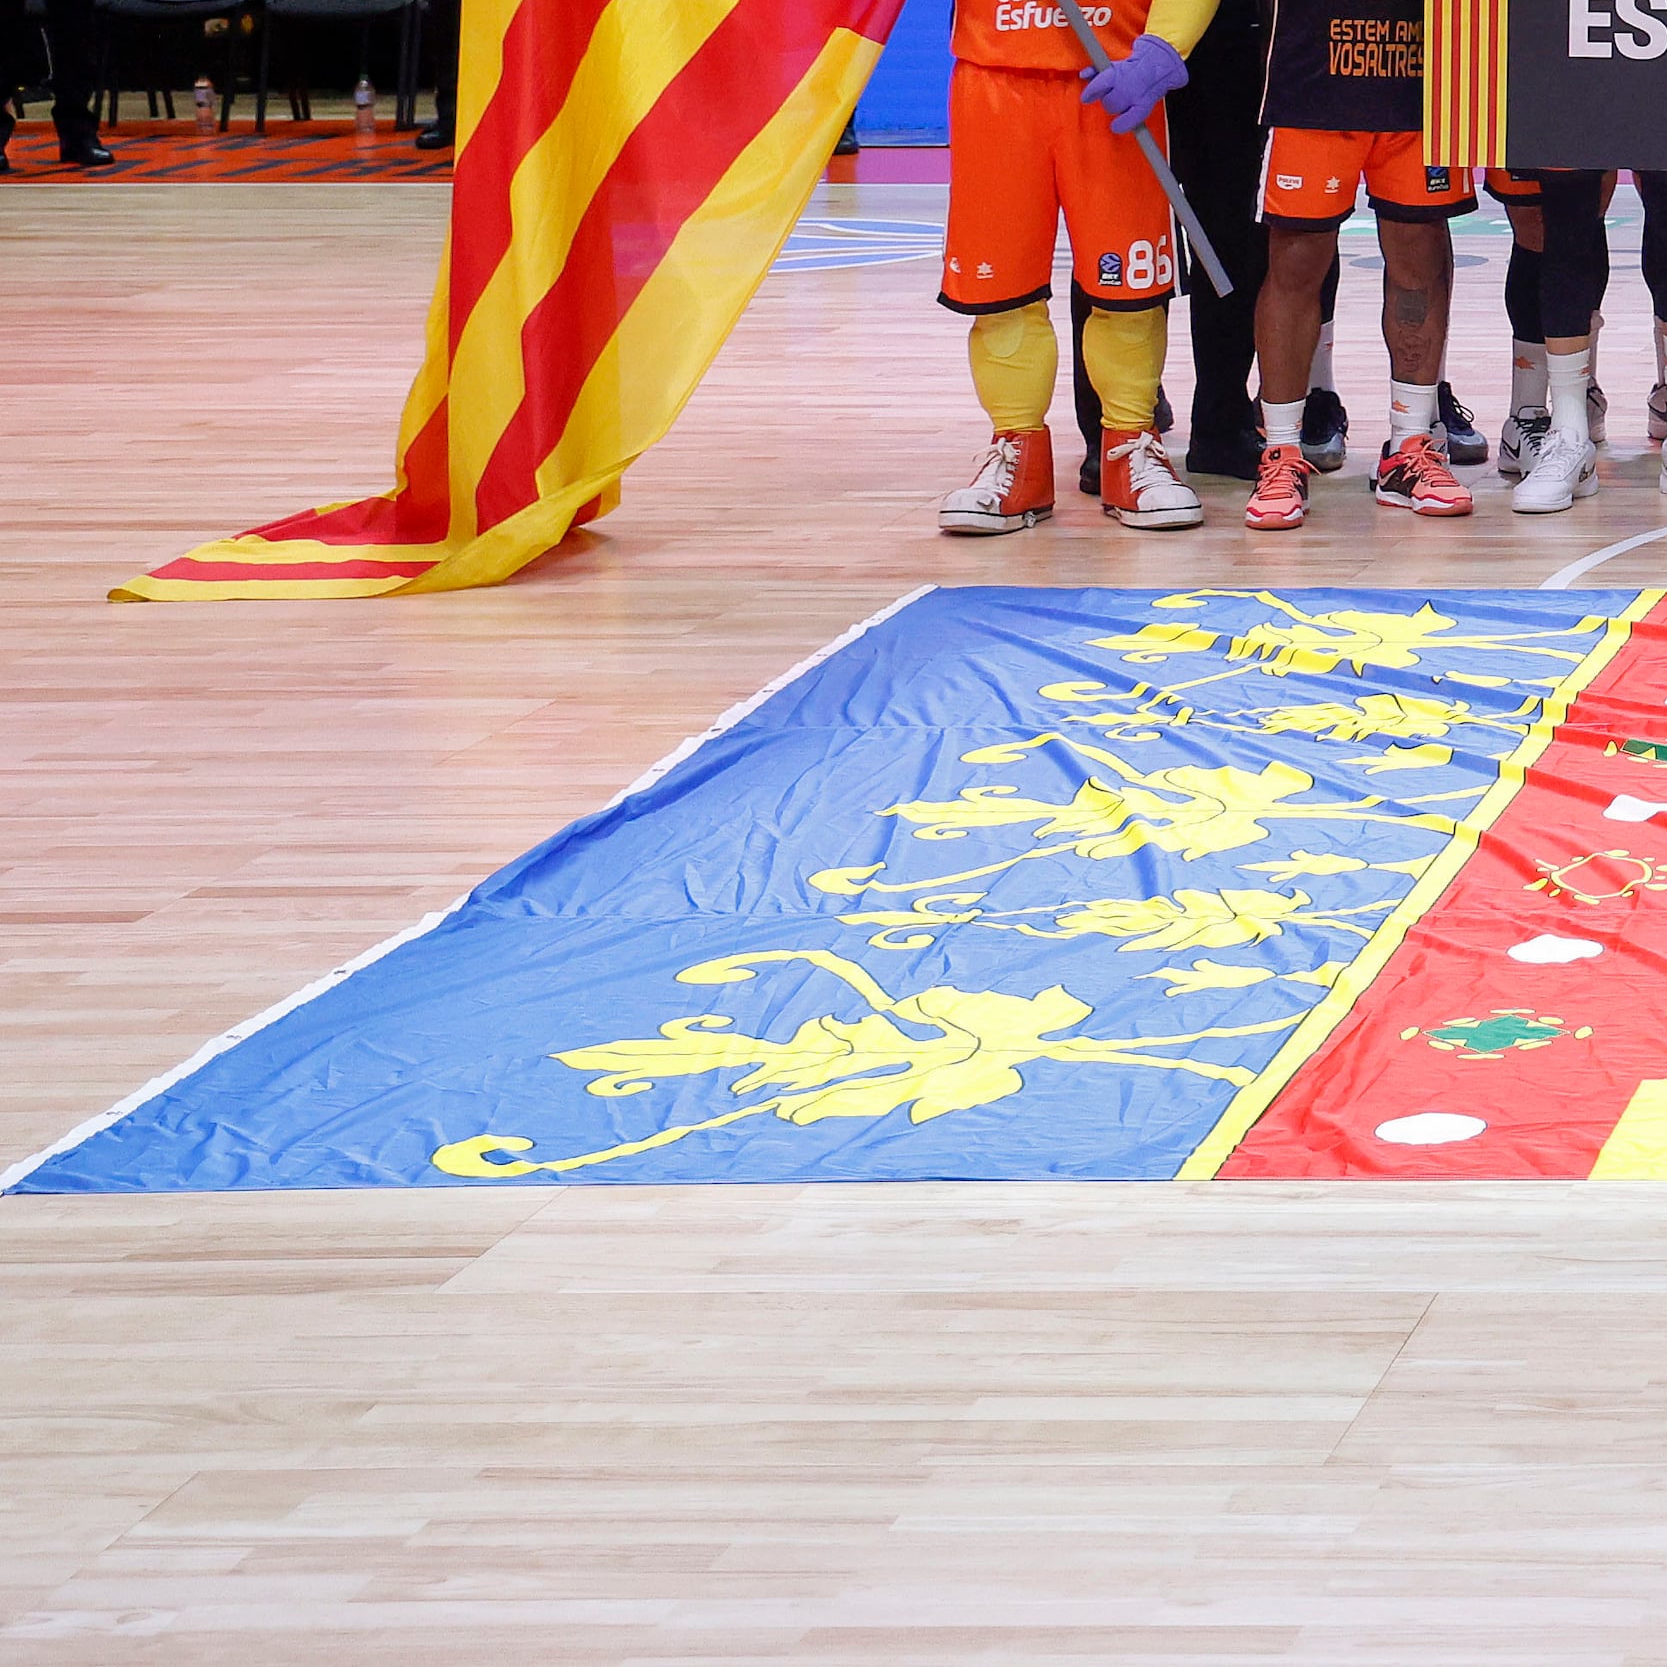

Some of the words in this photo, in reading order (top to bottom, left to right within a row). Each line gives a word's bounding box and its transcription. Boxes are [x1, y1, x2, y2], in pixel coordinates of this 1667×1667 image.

[995, 2, 1112, 31] Esfuezo
[1330, 19, 1390, 42] ESTEM
[1127, 235, 1172, 289] 86
